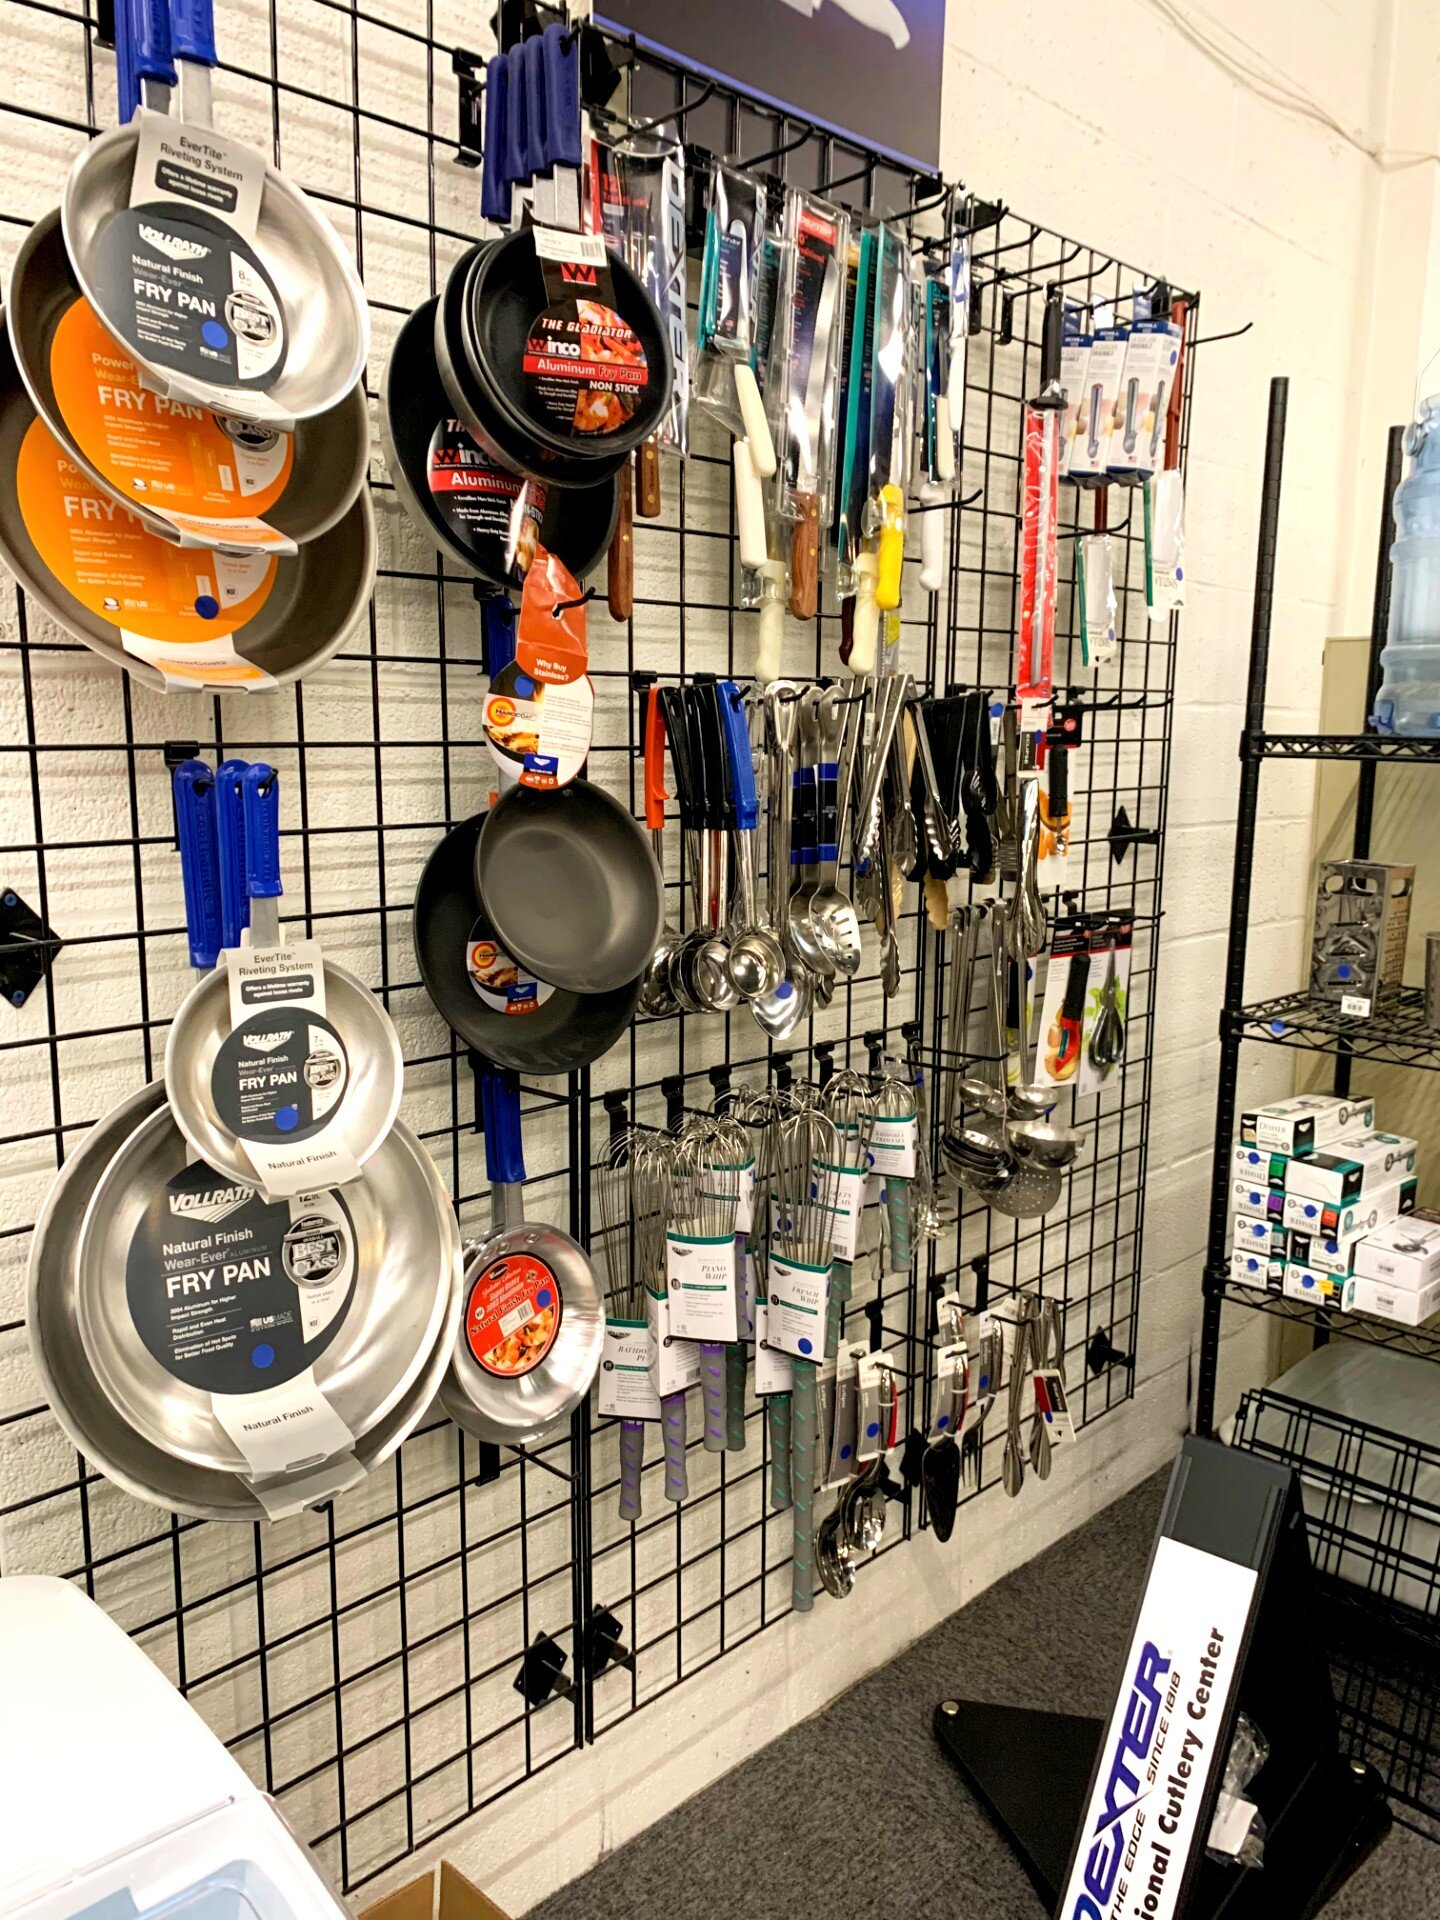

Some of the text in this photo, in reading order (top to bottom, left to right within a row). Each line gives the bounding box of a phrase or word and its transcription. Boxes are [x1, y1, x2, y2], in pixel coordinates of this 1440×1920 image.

[160, 142, 243, 181] Riveting System
[138, 223, 209, 259] VOLLRATH
[131, 254, 204, 285] Natural Finish
[133, 278, 172, 303] FRY
[177, 291, 216, 317] PAN
[541, 318, 633, 339] THE GLADIATOR
[537, 358, 642, 381] Aluminum Fry Pan
[589, 380, 640, 394] NON STICK
[97, 385, 146, 411] FRY
[154, 394, 203, 421] PAN
[450, 471, 521, 493] Aluminum
[63, 495, 117, 521] FRY
[533, 668, 570, 681] Stainless?
[536, 658, 567, 673] Why Buy
[238, 962, 313, 976] Riveting System
[243, 1030, 293, 1046] VOLLRATH
[237, 1055, 289, 1069] Natural Finish
[238, 1071, 298, 1091] FRY PAN
[267, 1150, 337, 1170] Natural Finish
[168, 1186, 256, 1212] VOLLRATH
[162, 1227, 253, 1256] Natural Finish
[292, 1236, 336, 1261] BEST
[163, 1244, 268, 1272] Wear-Ever ALUMINUM
[292, 1255, 339, 1278] CLASS
[166, 1256, 271, 1299] FRY PAN
[183, 1301, 210, 1311] Aluminum
[242, 1405, 314, 1432] Natural Finish
[1158, 1728, 1204, 1835] Cutlery
[1187, 1627, 1224, 1720] Center
[1124, 1809, 1146, 1873] EDGE
[1147, 1717, 1170, 1785] SINCE
[1165, 1671, 1181, 1714] 1818
